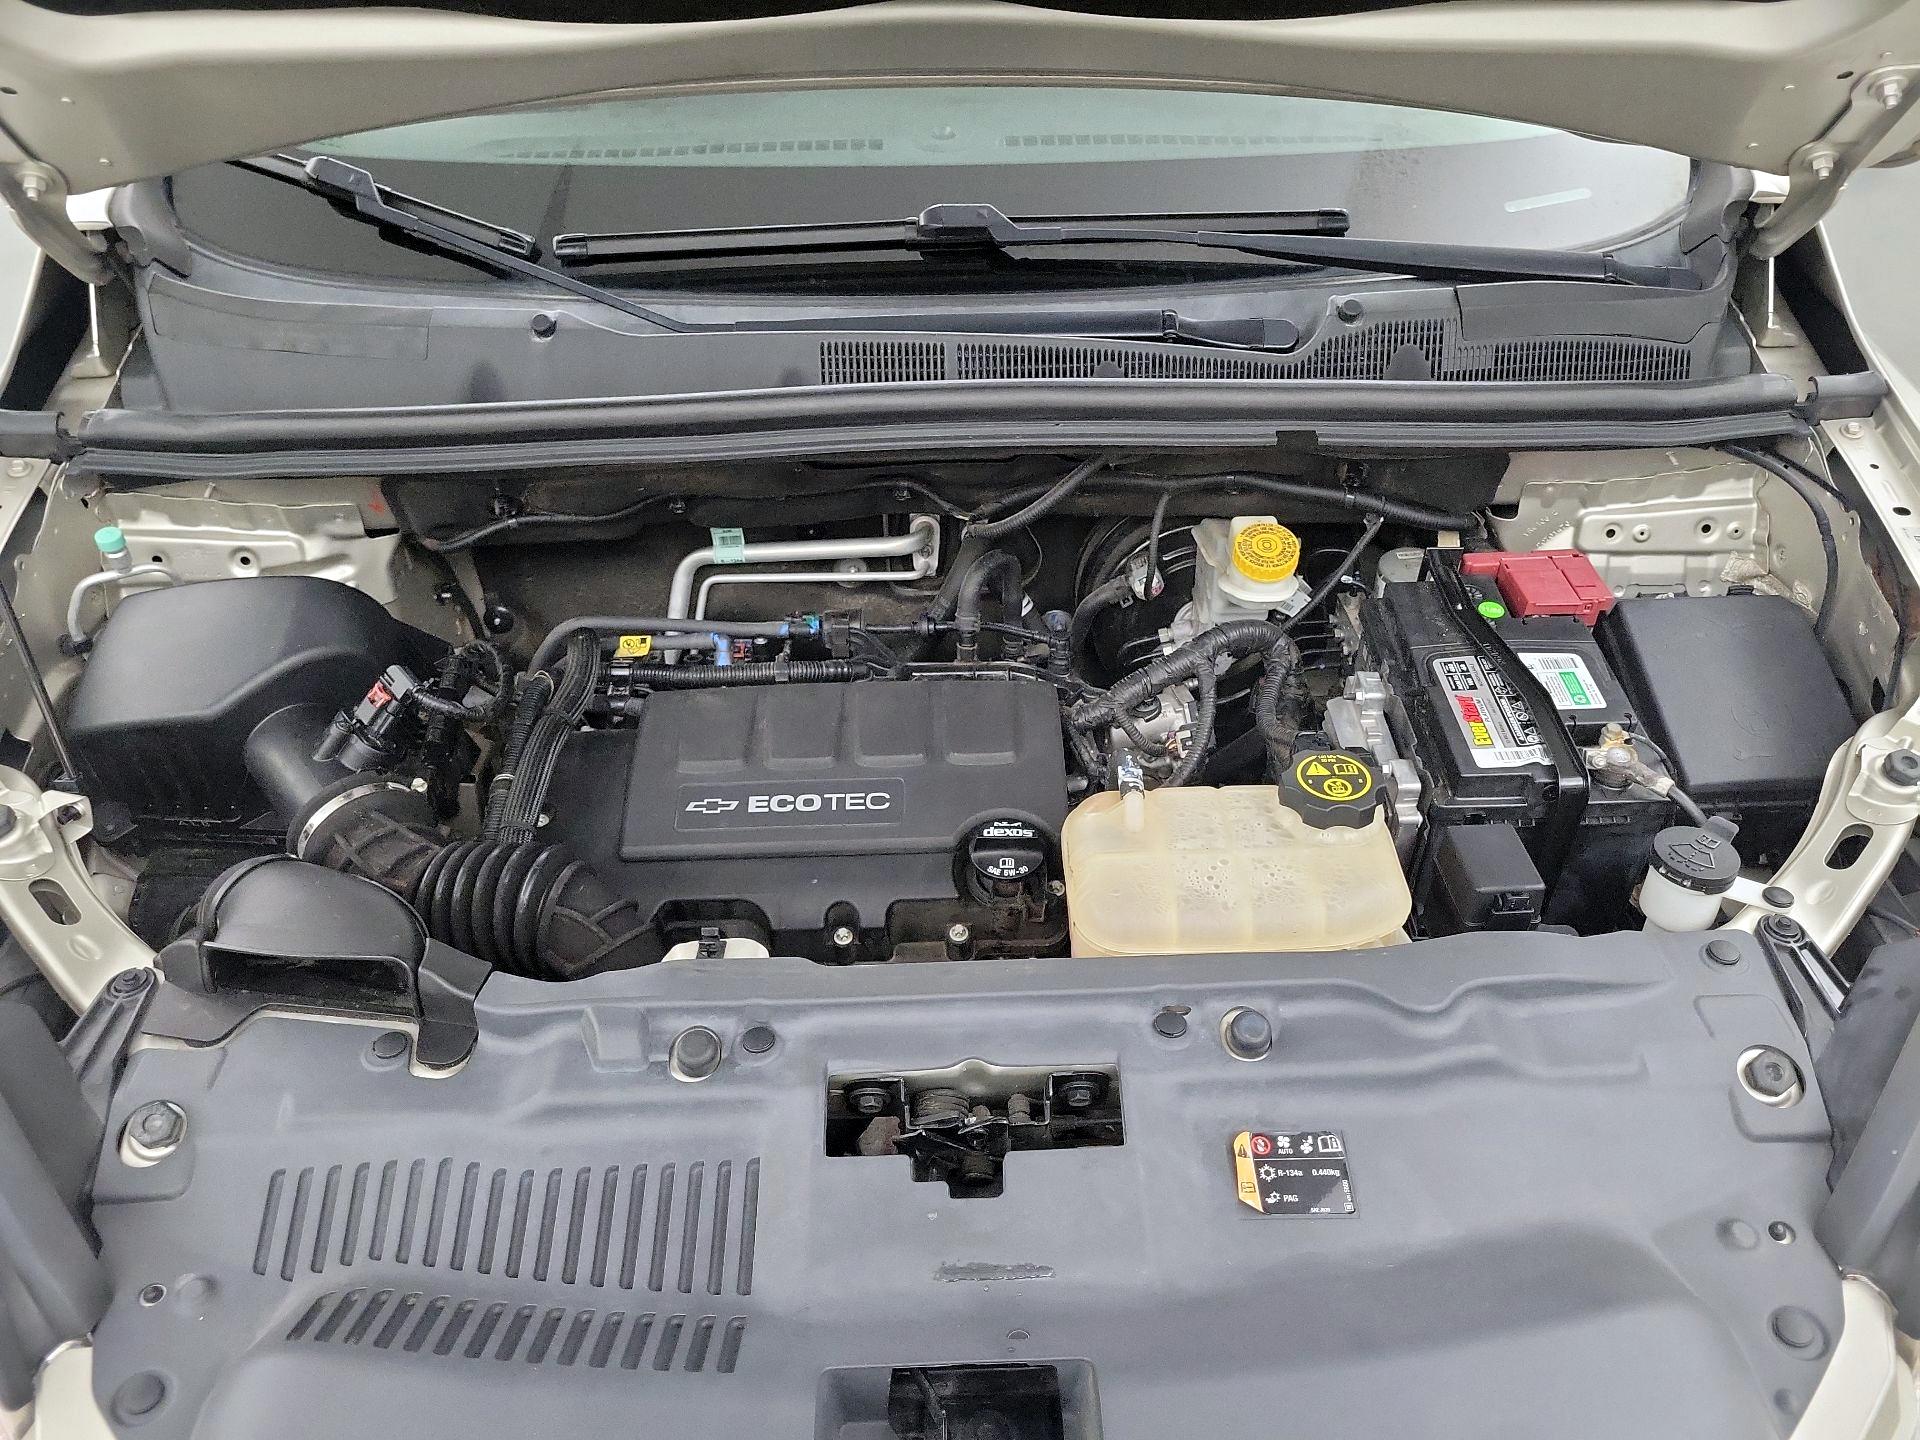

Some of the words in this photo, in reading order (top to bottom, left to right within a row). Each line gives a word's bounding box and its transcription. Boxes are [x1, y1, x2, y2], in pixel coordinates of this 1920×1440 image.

[1454, 694, 1493, 746] EverStart
[747, 792, 891, 813] ECOTEC
[982, 826, 1034, 837] dexos
[987, 865, 1001, 876] SAE
[1003, 865, 1029, 877] 5W-30
[1312, 1169, 1340, 1177] 0.440kg
